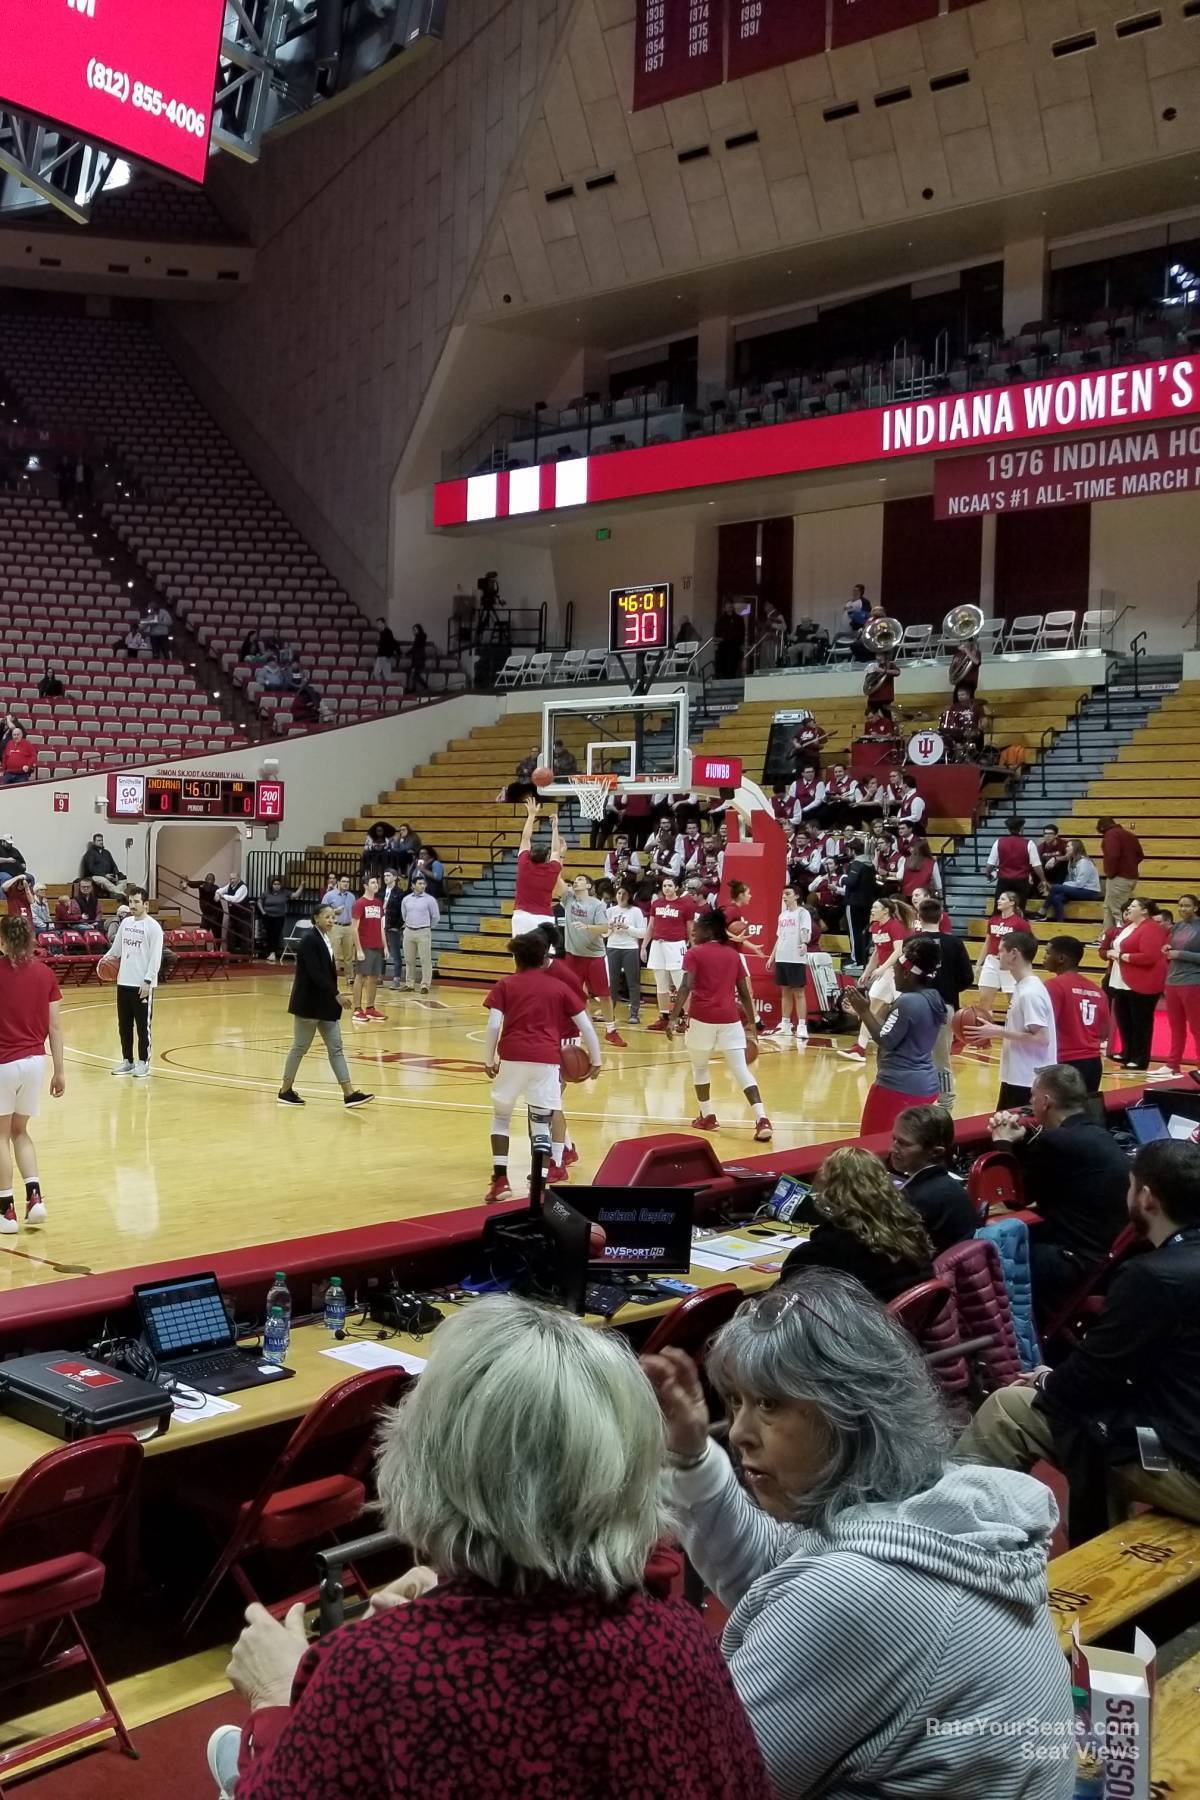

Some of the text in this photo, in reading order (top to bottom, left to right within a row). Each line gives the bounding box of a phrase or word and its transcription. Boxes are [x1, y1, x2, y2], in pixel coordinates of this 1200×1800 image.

[689, 4, 709, 23] 1974
[741, 2, 761, 22] 1989
[646, 21, 664, 39] 1953
[689, 22, 708, 41] 1975
[741, 20, 759, 39] 1991
[645, 37, 664, 57] 1954
[645, 53, 664, 73] 1957
[87, 57, 205, 138] (812) 855-4006
[882, 361, 1193, 451] INDIANA WOMEN'S
[986, 449, 1044, 481] 1976
[1053, 433, 1159, 473] INDIANA
[948, 491, 1006, 515] NCAA'S
[1010, 489, 1030, 508] #1
[1035, 477, 1116, 505] ALL-TIME
[1122, 468, 1189, 495] MARCH
[618, 593, 664, 611] 46:01
[625, 612, 658, 643] 30
[705, 763, 730, 779] #IUWBB
[122, 787, 137, 798] GO
[148, 778, 181, 789] INDIANA
[59, 799, 64, 810] 9
[161, 794, 168, 810] 0
[243, 797, 251, 813] 0
[262, 791, 278, 801] 200
[1120, 1542, 1175, 1563] 102
